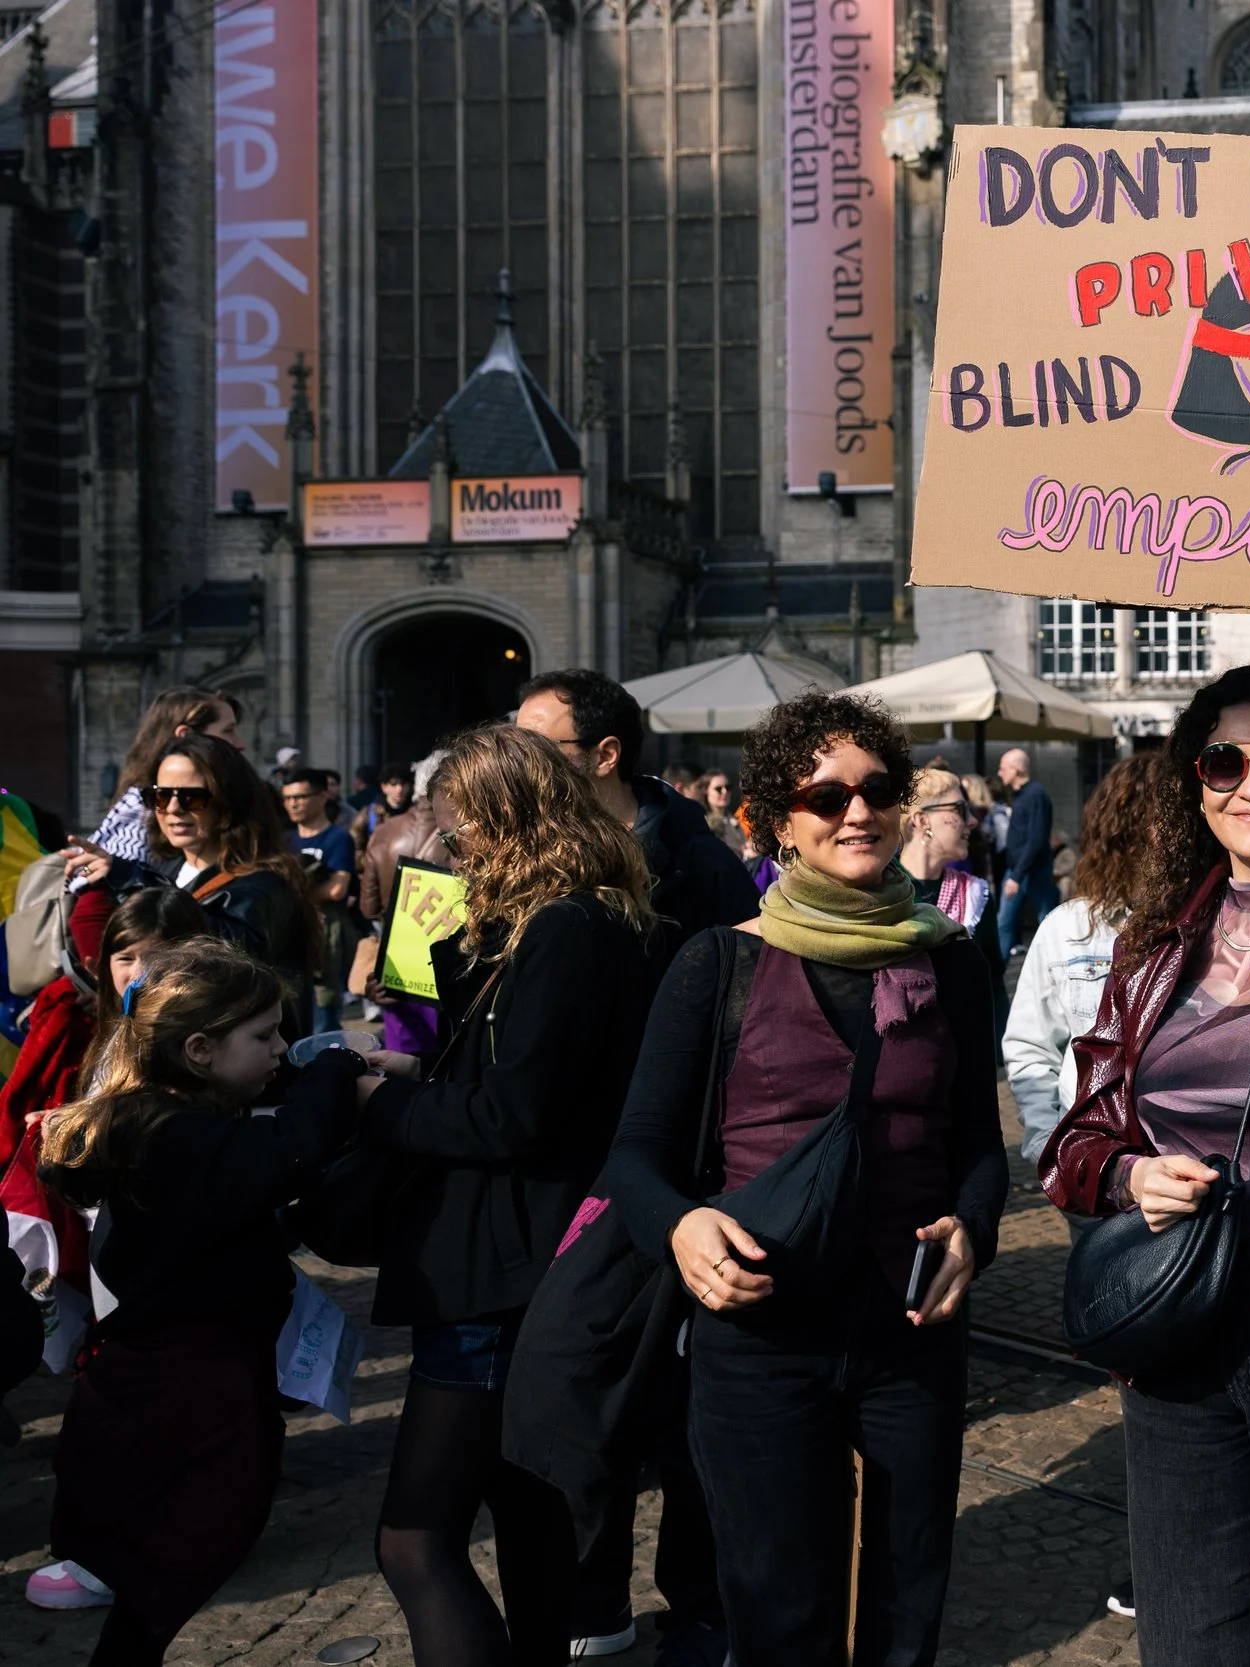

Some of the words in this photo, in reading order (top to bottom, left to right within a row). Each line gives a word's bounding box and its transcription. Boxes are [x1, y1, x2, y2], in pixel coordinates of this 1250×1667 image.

[821, 33, 875, 229] biografie
[981, 137, 1211, 228] DON'T
[833, 237, 864, 320] van
[216, 219, 308, 469] Kerk
[826, 325, 877, 455] Joods
[943, 354, 1142, 433] BLIND
[461, 482, 562, 512] Mokum
[384, 973, 436, 995] DECOLONIZE
